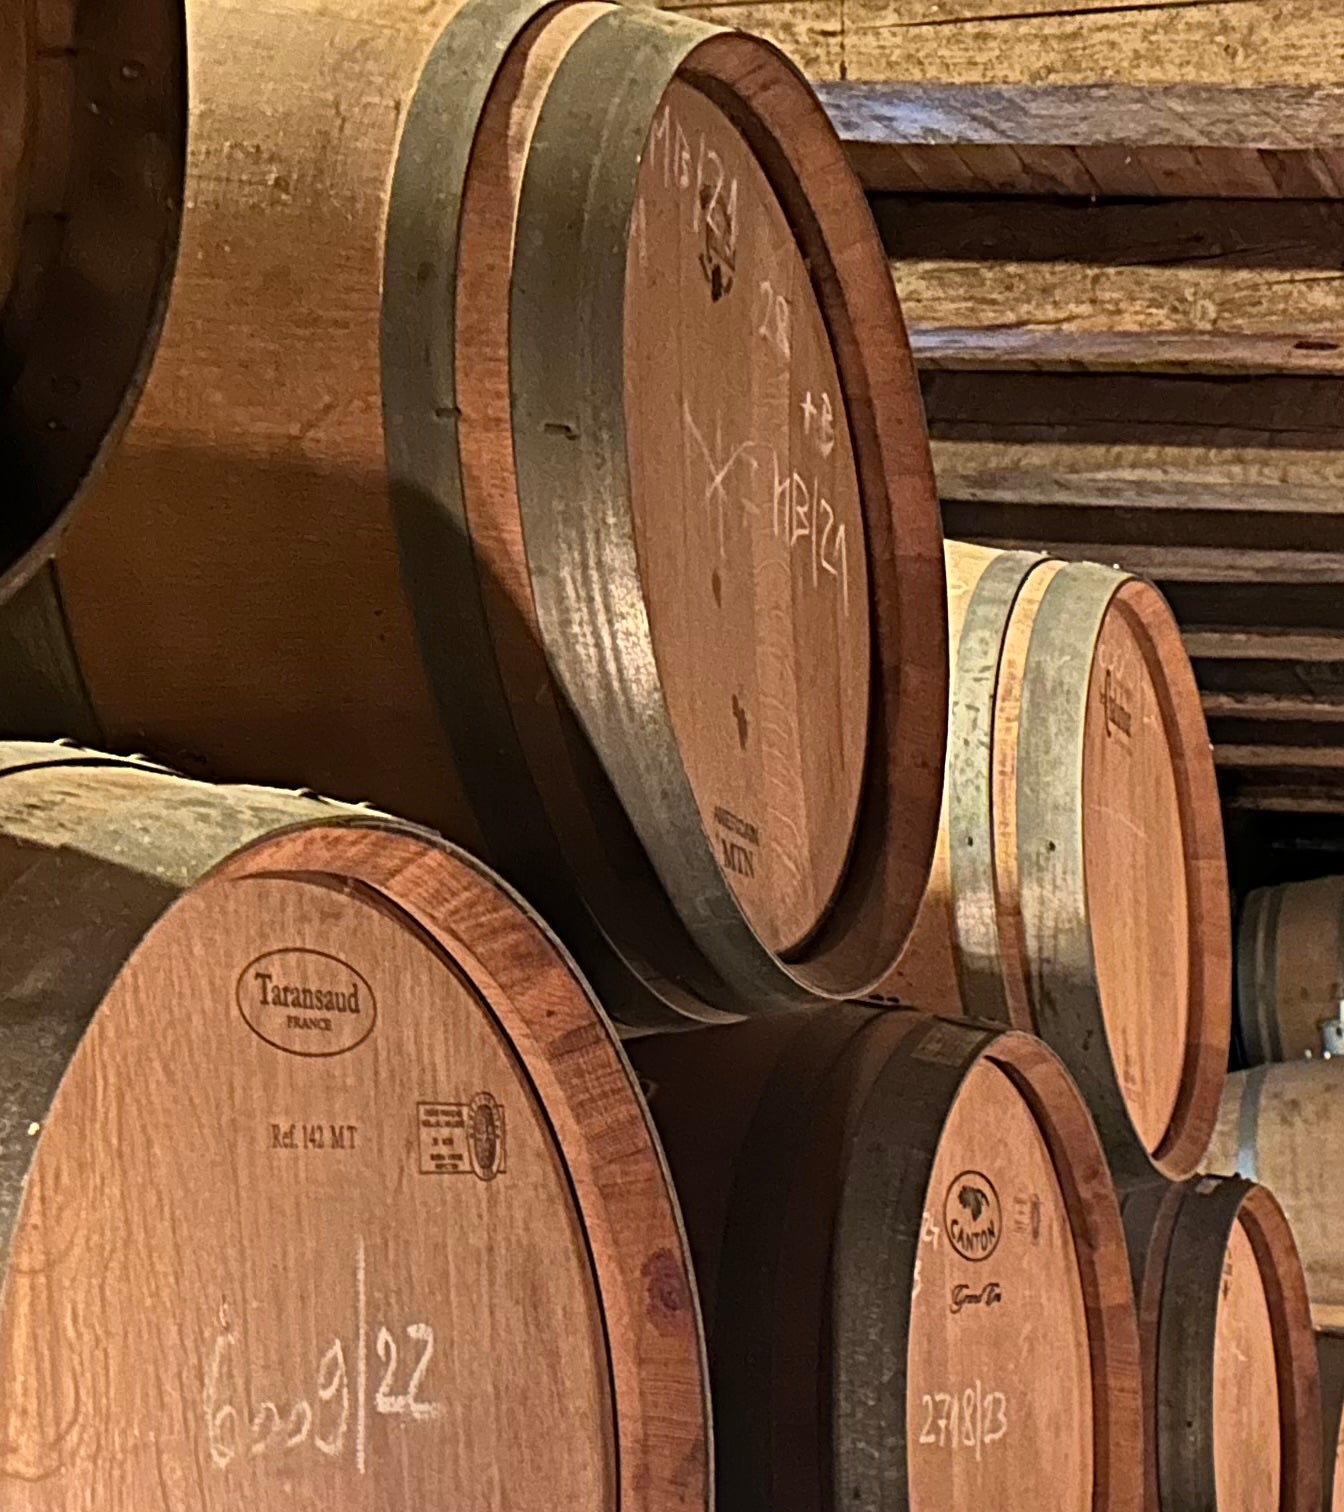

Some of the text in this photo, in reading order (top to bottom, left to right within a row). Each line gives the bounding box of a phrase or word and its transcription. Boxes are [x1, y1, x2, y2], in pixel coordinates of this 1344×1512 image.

[254, 971, 361, 1015] Taransaud
[286, 1014, 333, 1032] FRANCE
[302, 1124, 325, 1150] 142
[950, 1218, 997, 1252] CANTON
